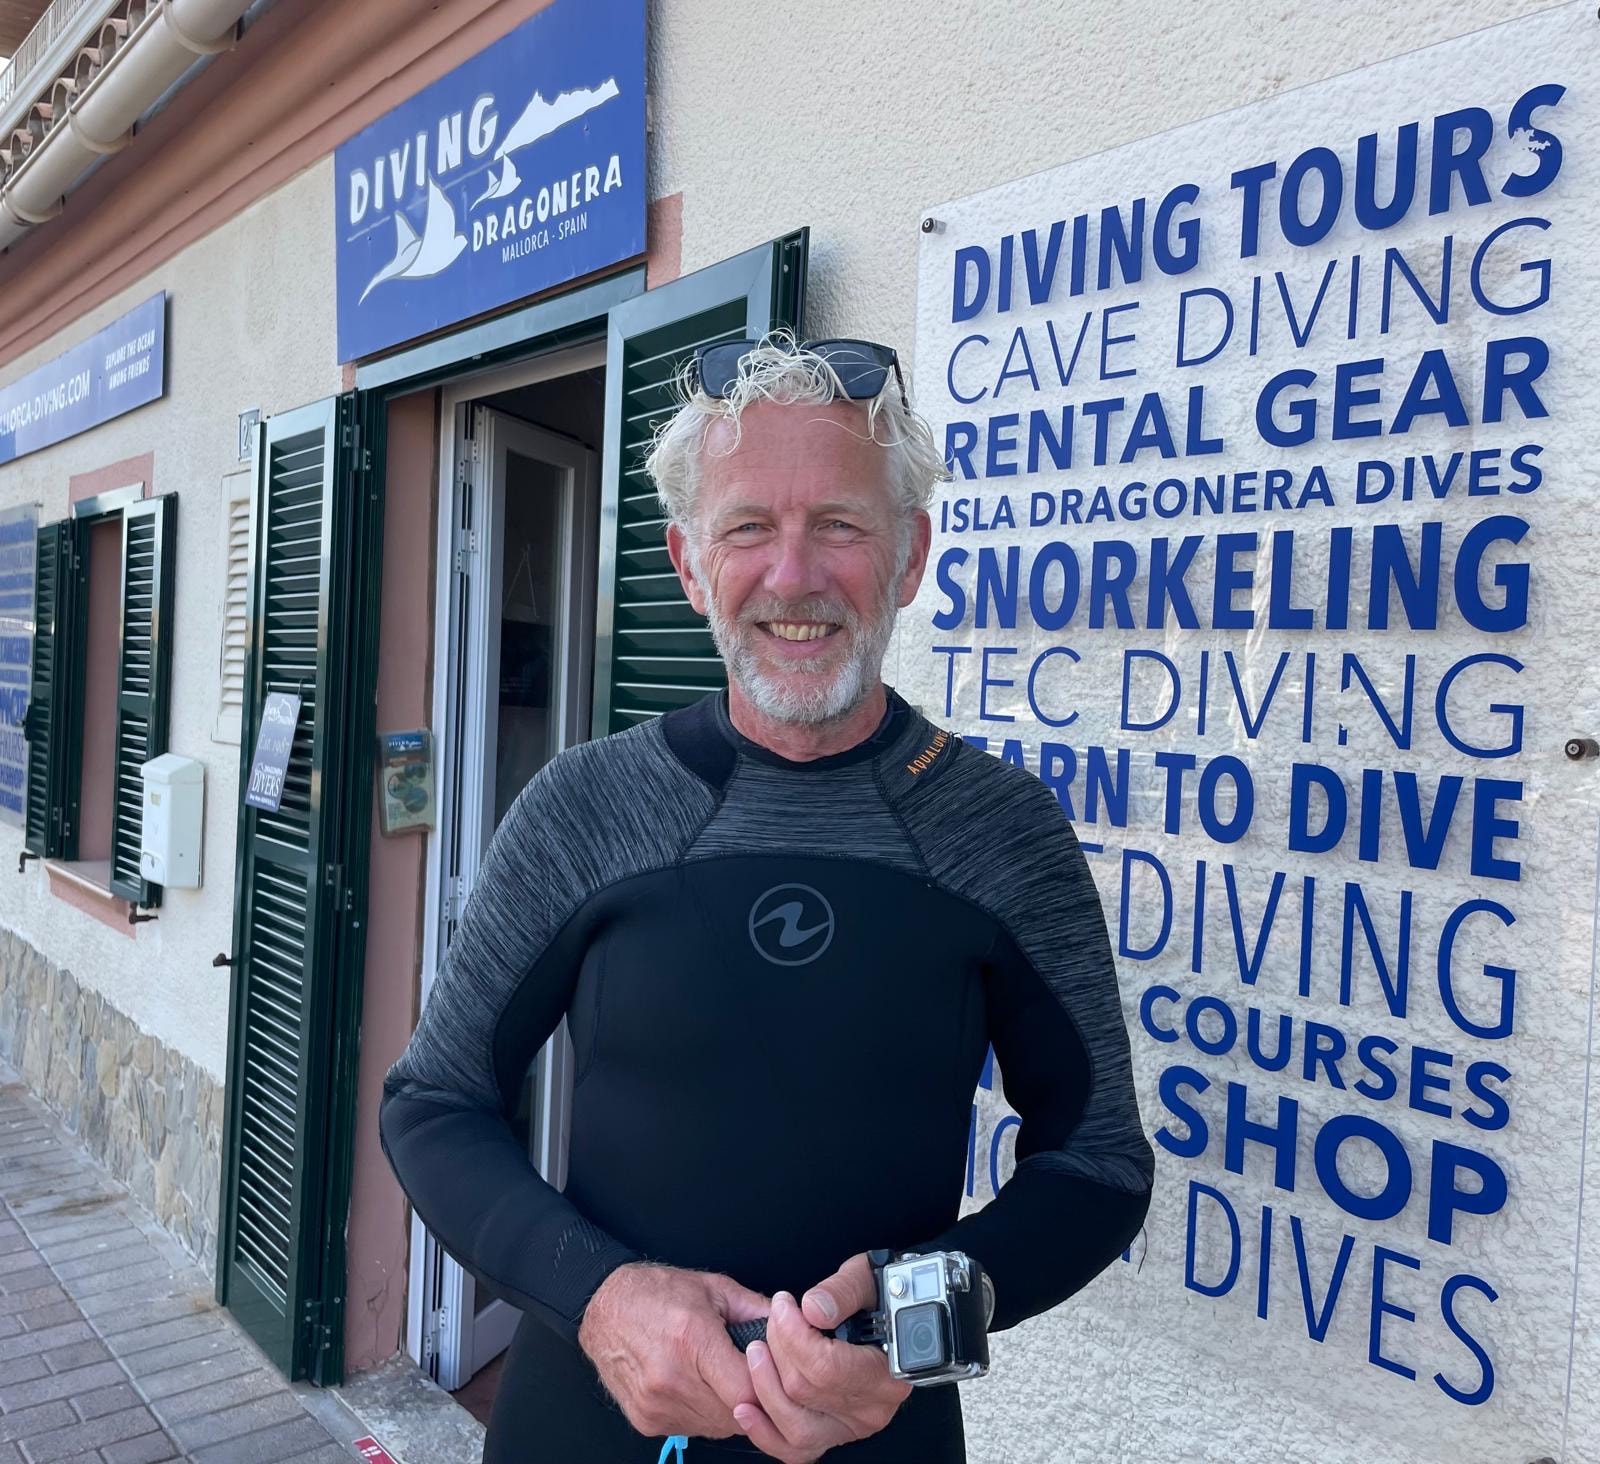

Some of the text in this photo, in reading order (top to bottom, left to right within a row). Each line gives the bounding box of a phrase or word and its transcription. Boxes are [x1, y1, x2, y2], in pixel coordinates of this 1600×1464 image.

[350, 96, 499, 225] DIVING
[472, 154, 622, 252] DRAGONERA
[951, 83, 1567, 323] DIVING TOURS
[501, 229, 550, 265] MALLORCA
[558, 212, 588, 241] SPAIN
[127, 339, 137, 358] THE
[137, 328, 156, 352] OCEAN
[947, 216, 1552, 404] CAVE DIVING
[945, 337, 1549, 480] RENTAL GEAR
[941, 444, 1543, 533] ISLA DRAGONERA DIVES
[931, 515, 1531, 633] SNORKELING
[932, 646, 1525, 759] TEC DIVING
[252, 766, 281, 798] DIVERS
[1154, 751, 1254, 844] TO
[1288, 762, 1524, 882] DIVE
[1118, 848, 1517, 1040] DIVING
[1139, 985, 1512, 1131] COURSES
[1154, 1065, 1510, 1245] SHOP
[1184, 1180, 1499, 1406] DIVES
